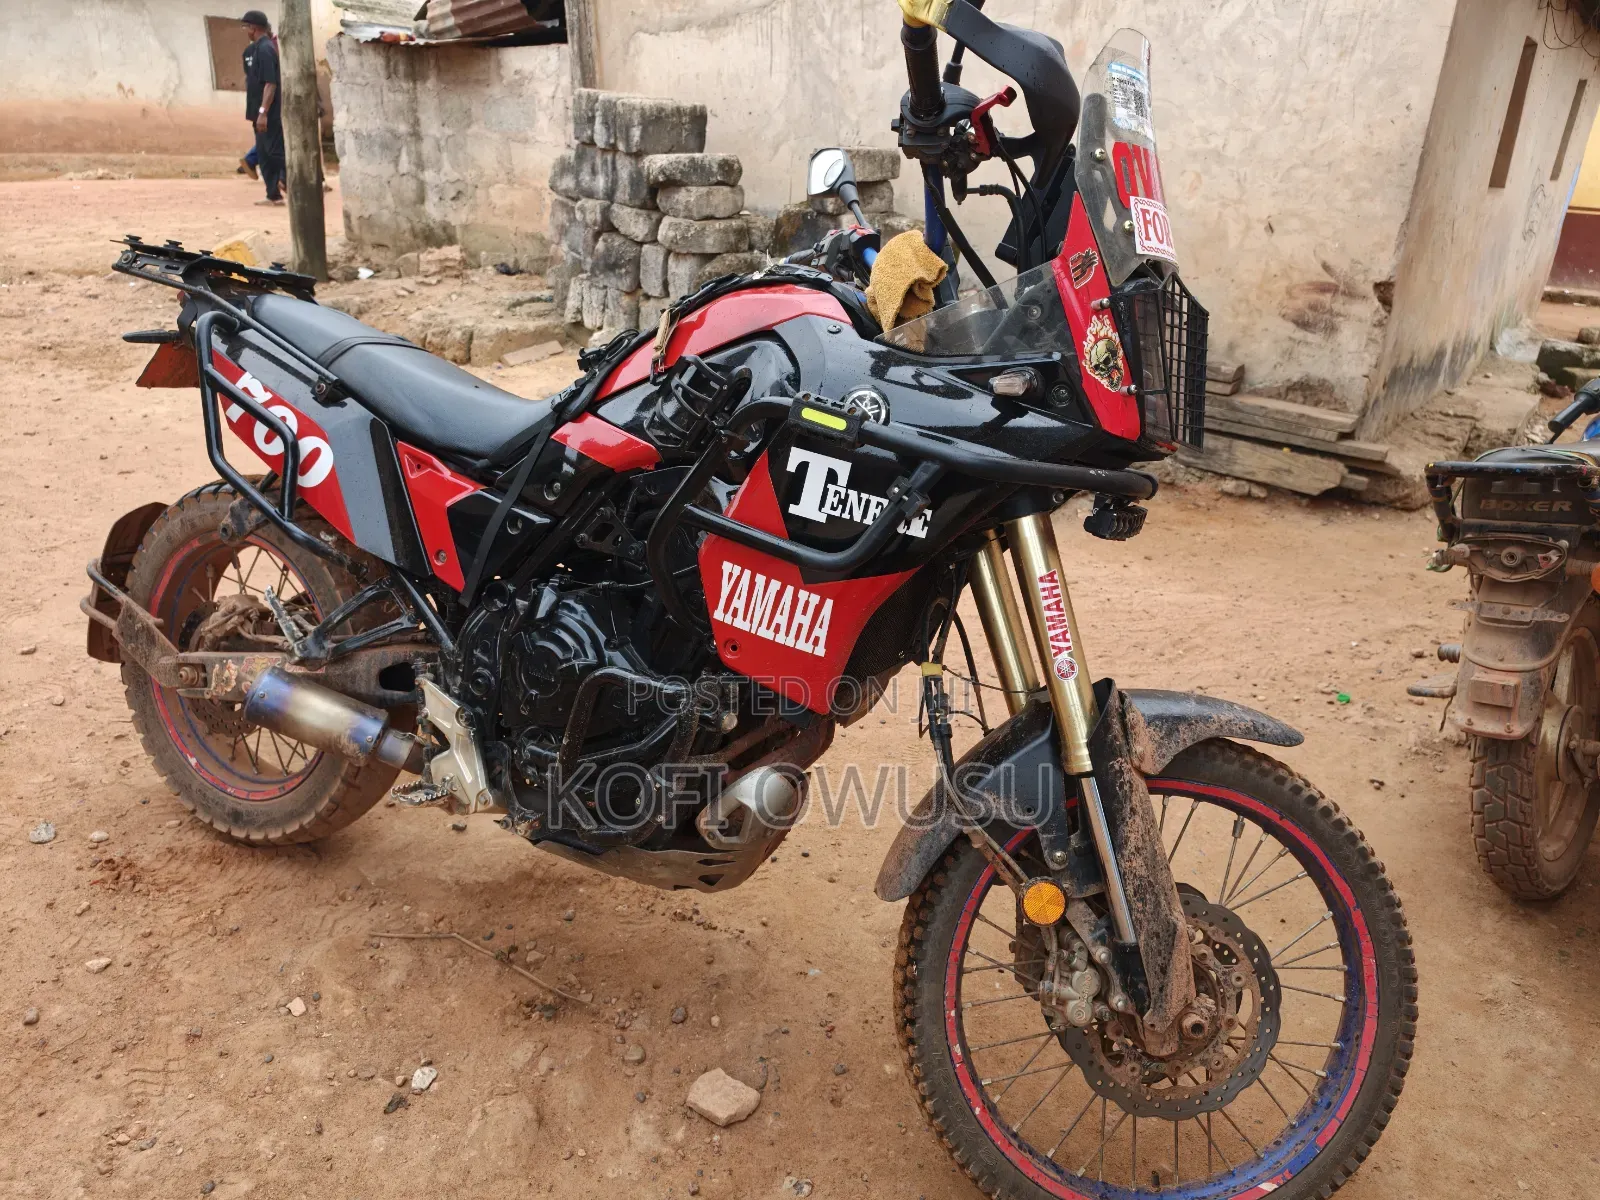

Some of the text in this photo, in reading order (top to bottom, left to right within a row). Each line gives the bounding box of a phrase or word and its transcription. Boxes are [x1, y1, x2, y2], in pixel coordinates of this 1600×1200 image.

[786, 446, 932, 539] TENEE
[1480, 499, 1573, 512] BOXER
[713, 560, 834, 657] YAMAHA
[1038, 569, 1073, 659] YAMAHA
